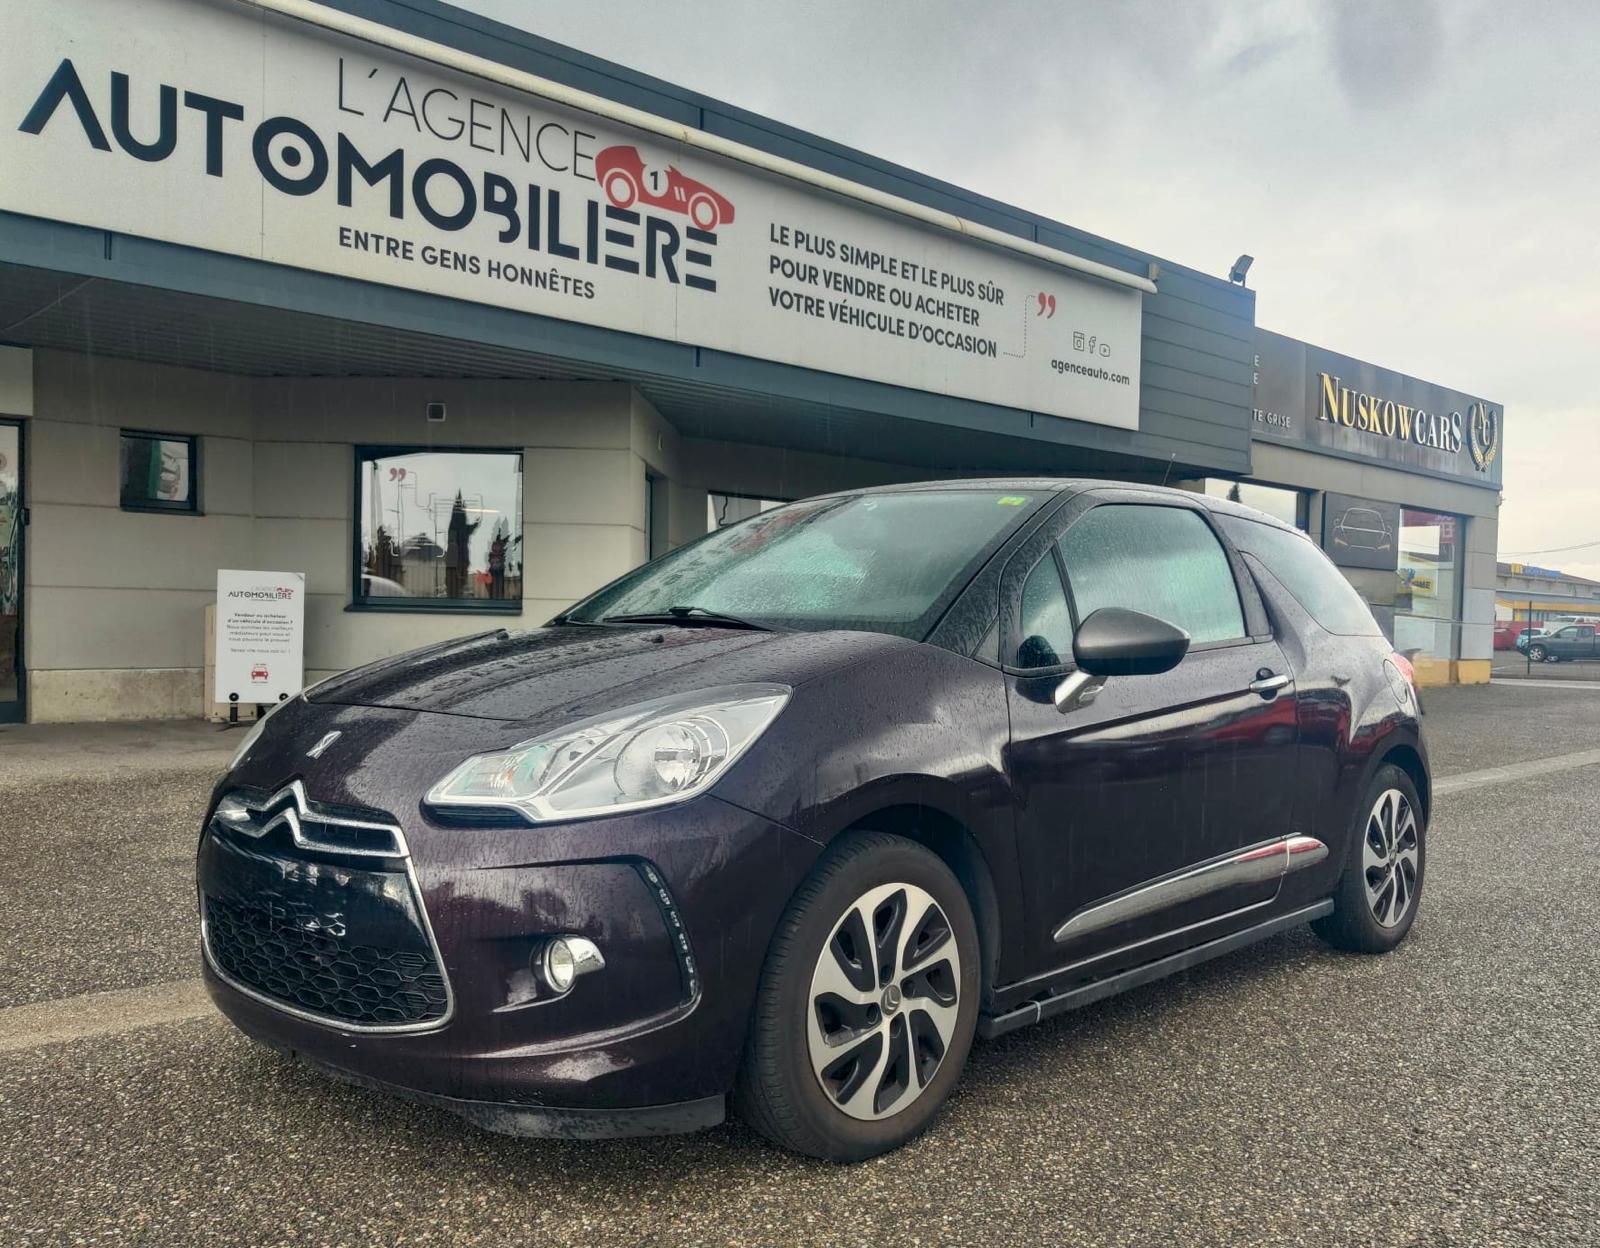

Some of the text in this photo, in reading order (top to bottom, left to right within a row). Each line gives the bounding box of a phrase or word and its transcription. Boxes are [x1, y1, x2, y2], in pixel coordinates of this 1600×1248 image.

[18, 57, 718, 293] AUTOMOBILIERE
[650, 170, 659, 191] 1
[339, 227, 596, 299] ENTRE GENS HONNÊTES
[769, 254, 980, 327] POUR VENDRE OU ACHETER
[770, 222, 1005, 306] LE PLUS SIMPLE ET LE PLUS SÛR
[768, 286, 997, 359] VOTRE VÉHICULE D'OCCASION
[1051, 358, 1131, 386] agenceauto.com
[1266, 412, 1291, 428] GRISE
